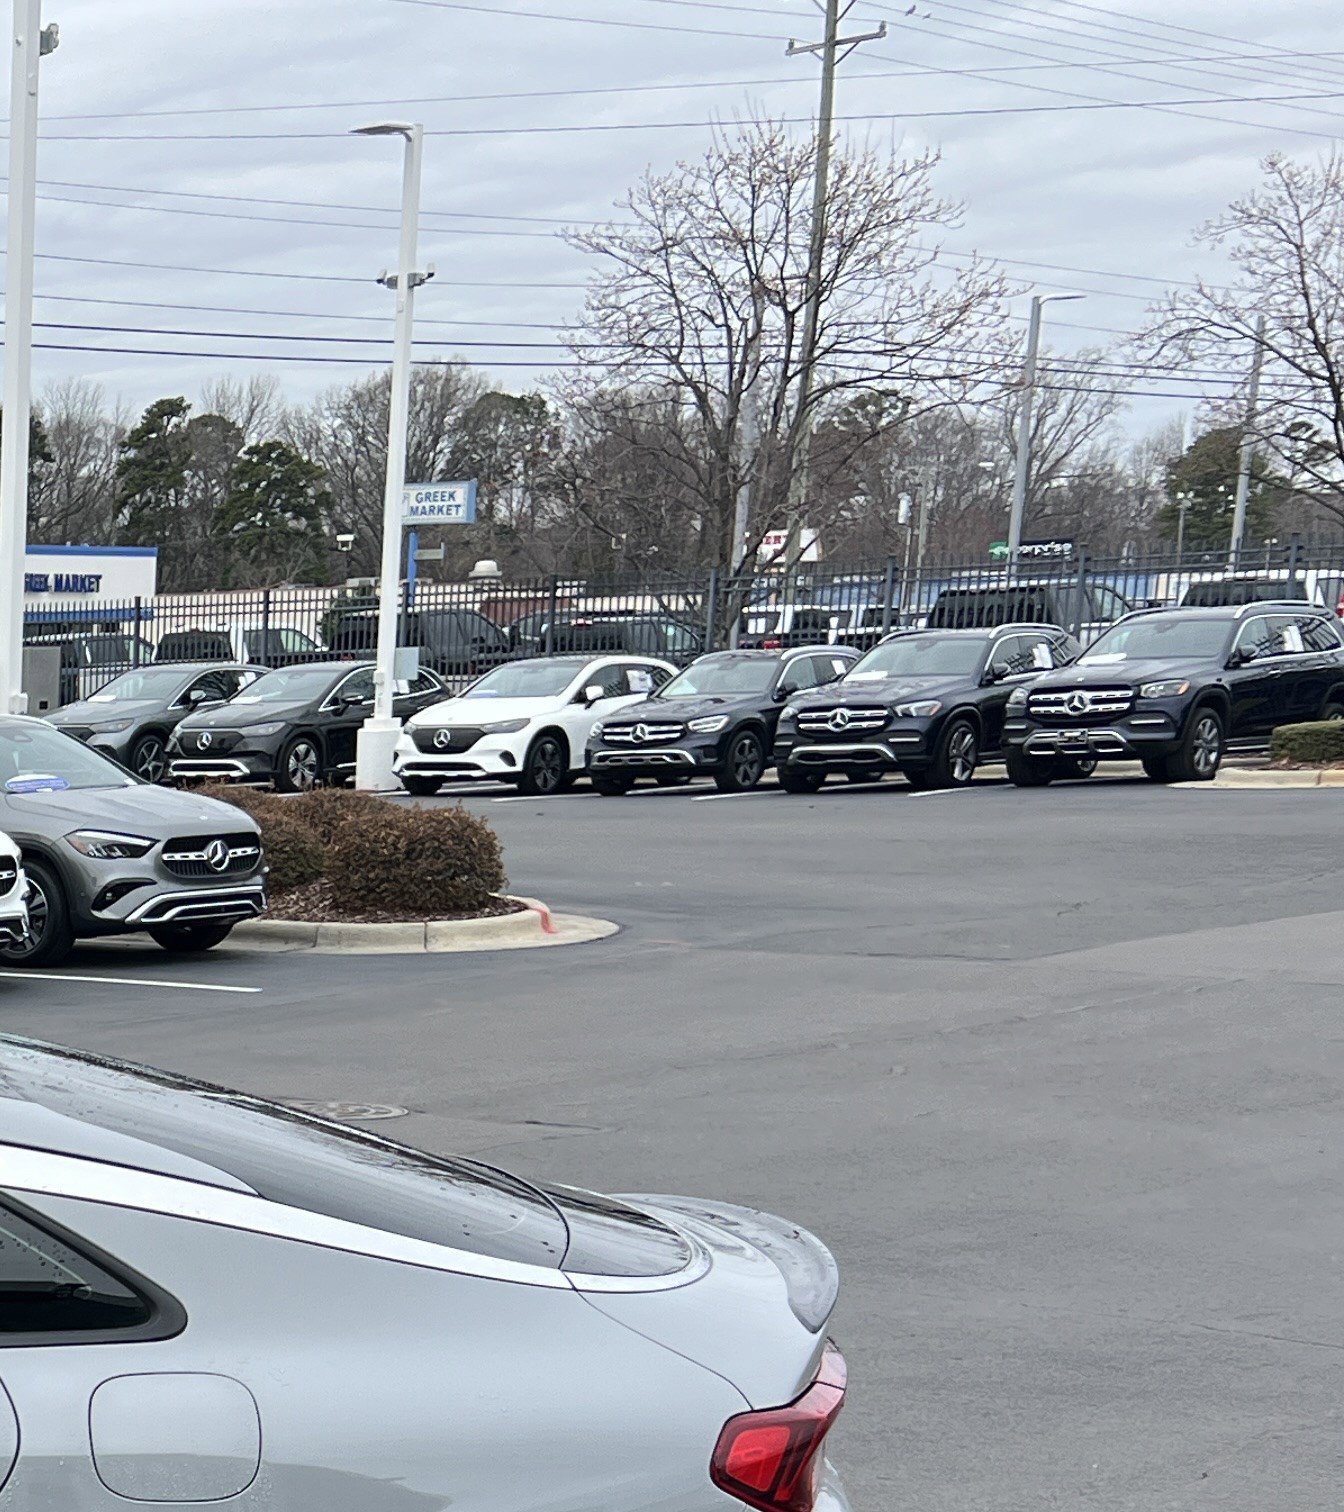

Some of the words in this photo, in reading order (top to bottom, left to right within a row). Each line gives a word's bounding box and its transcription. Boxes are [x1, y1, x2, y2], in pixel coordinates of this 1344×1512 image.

[415, 491, 456, 504] GREEK
[410, 504, 461, 516] MARKET
[53, 573, 102, 592] MARKET
